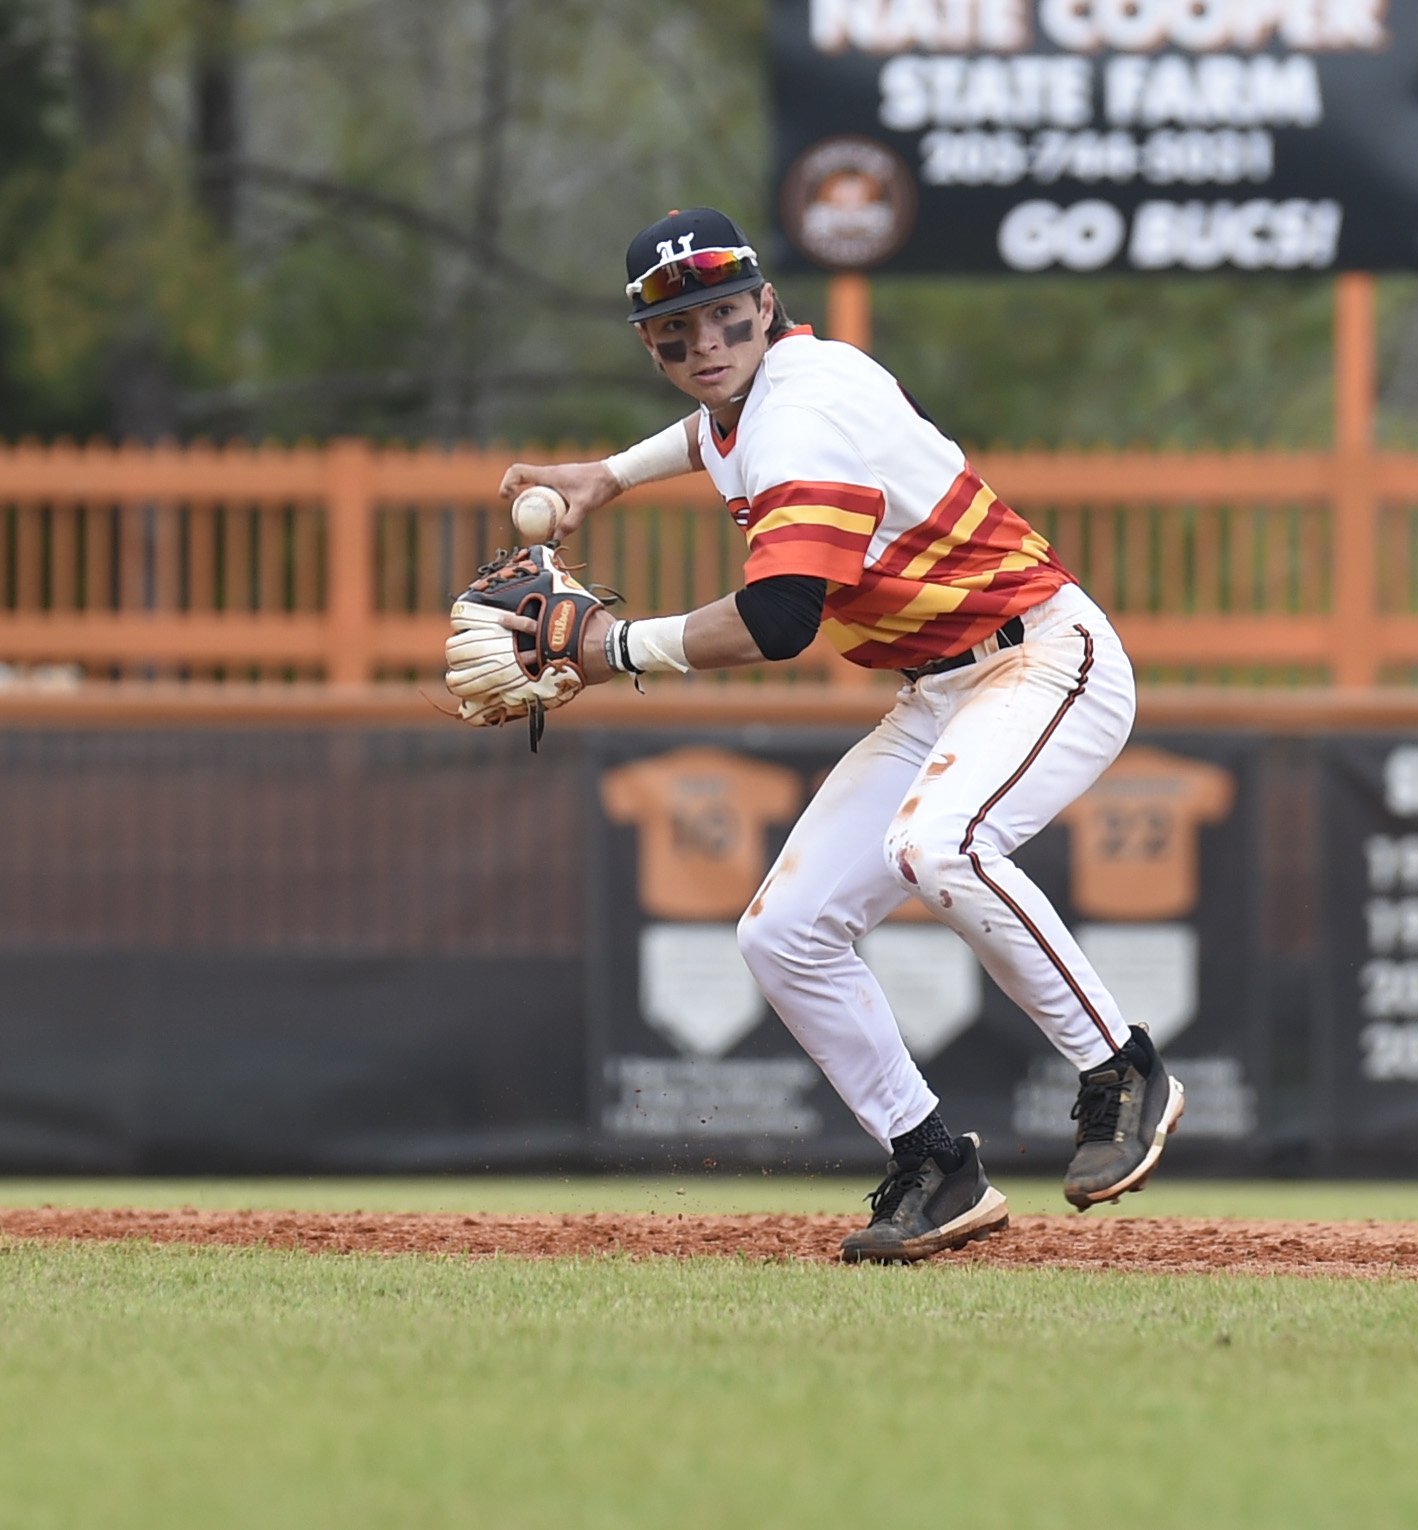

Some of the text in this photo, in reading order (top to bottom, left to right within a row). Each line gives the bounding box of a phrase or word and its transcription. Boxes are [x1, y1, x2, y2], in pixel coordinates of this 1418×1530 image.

[880, 55, 1323, 129] STATE FARM
[999, 200, 1126, 271] GO
